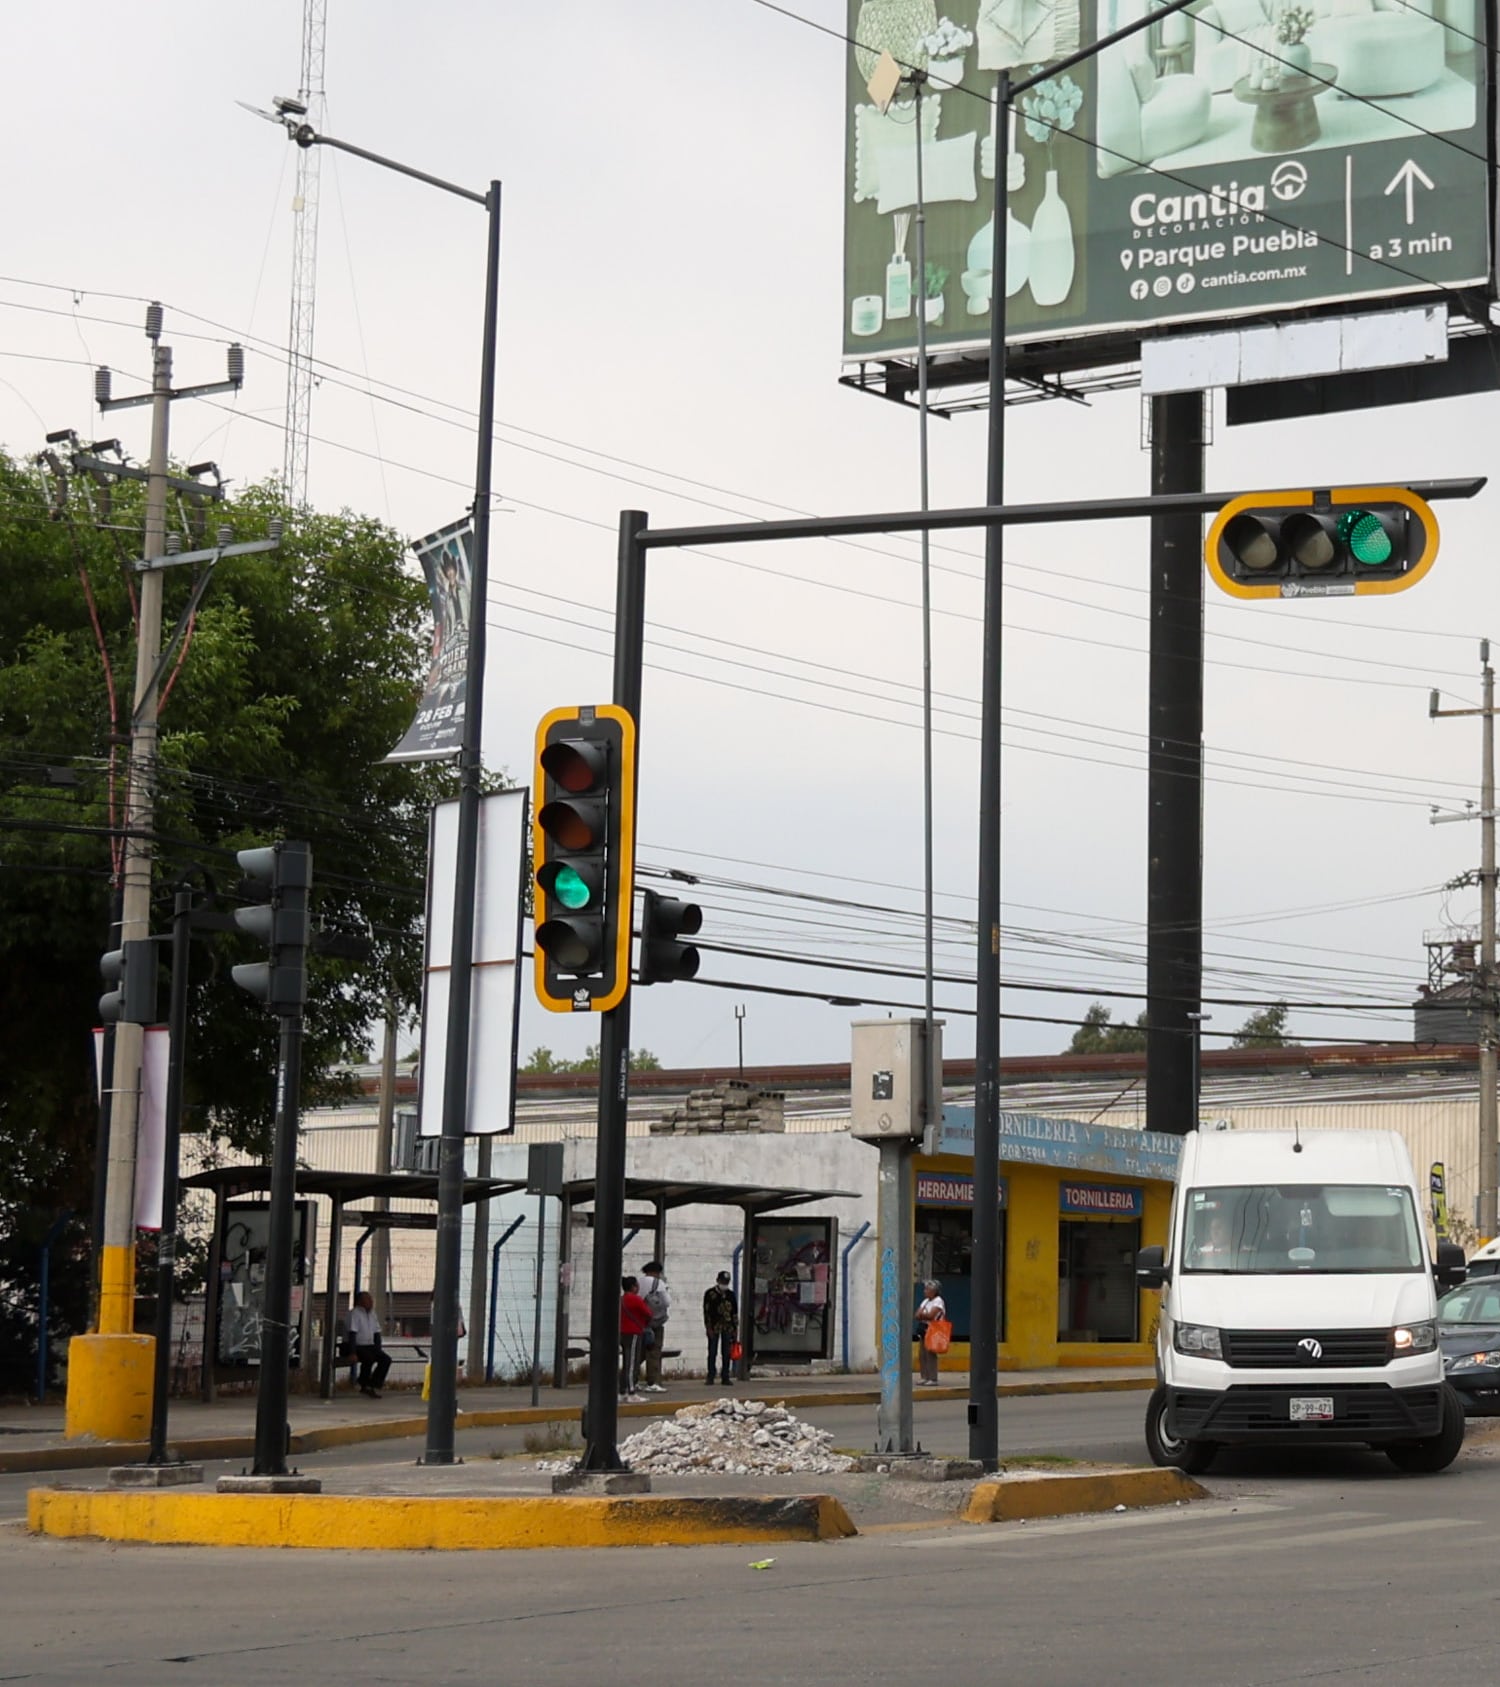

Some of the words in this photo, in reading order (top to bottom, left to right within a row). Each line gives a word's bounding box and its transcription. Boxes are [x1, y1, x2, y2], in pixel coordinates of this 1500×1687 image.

[1130, 181, 1265, 227] Cantia
[1133, 213, 1265, 240] DECORACIÓN
[1138, 241, 1226, 269] Parque
[1233, 228, 1319, 257] Puebla
[1369, 245, 1383, 260] a
[1389, 239, 1402, 258] 3
[1408, 232, 1452, 256] min
[1201, 265, 1307, 288] cantia.com.mx
[432, 704, 454, 721] FEB
[999, 1112, 1077, 1144] RNILLERIA
[918, 1180, 1002, 1203] HERRAMIES
[1065, 1187, 1135, 1210] TORNILLERIA
